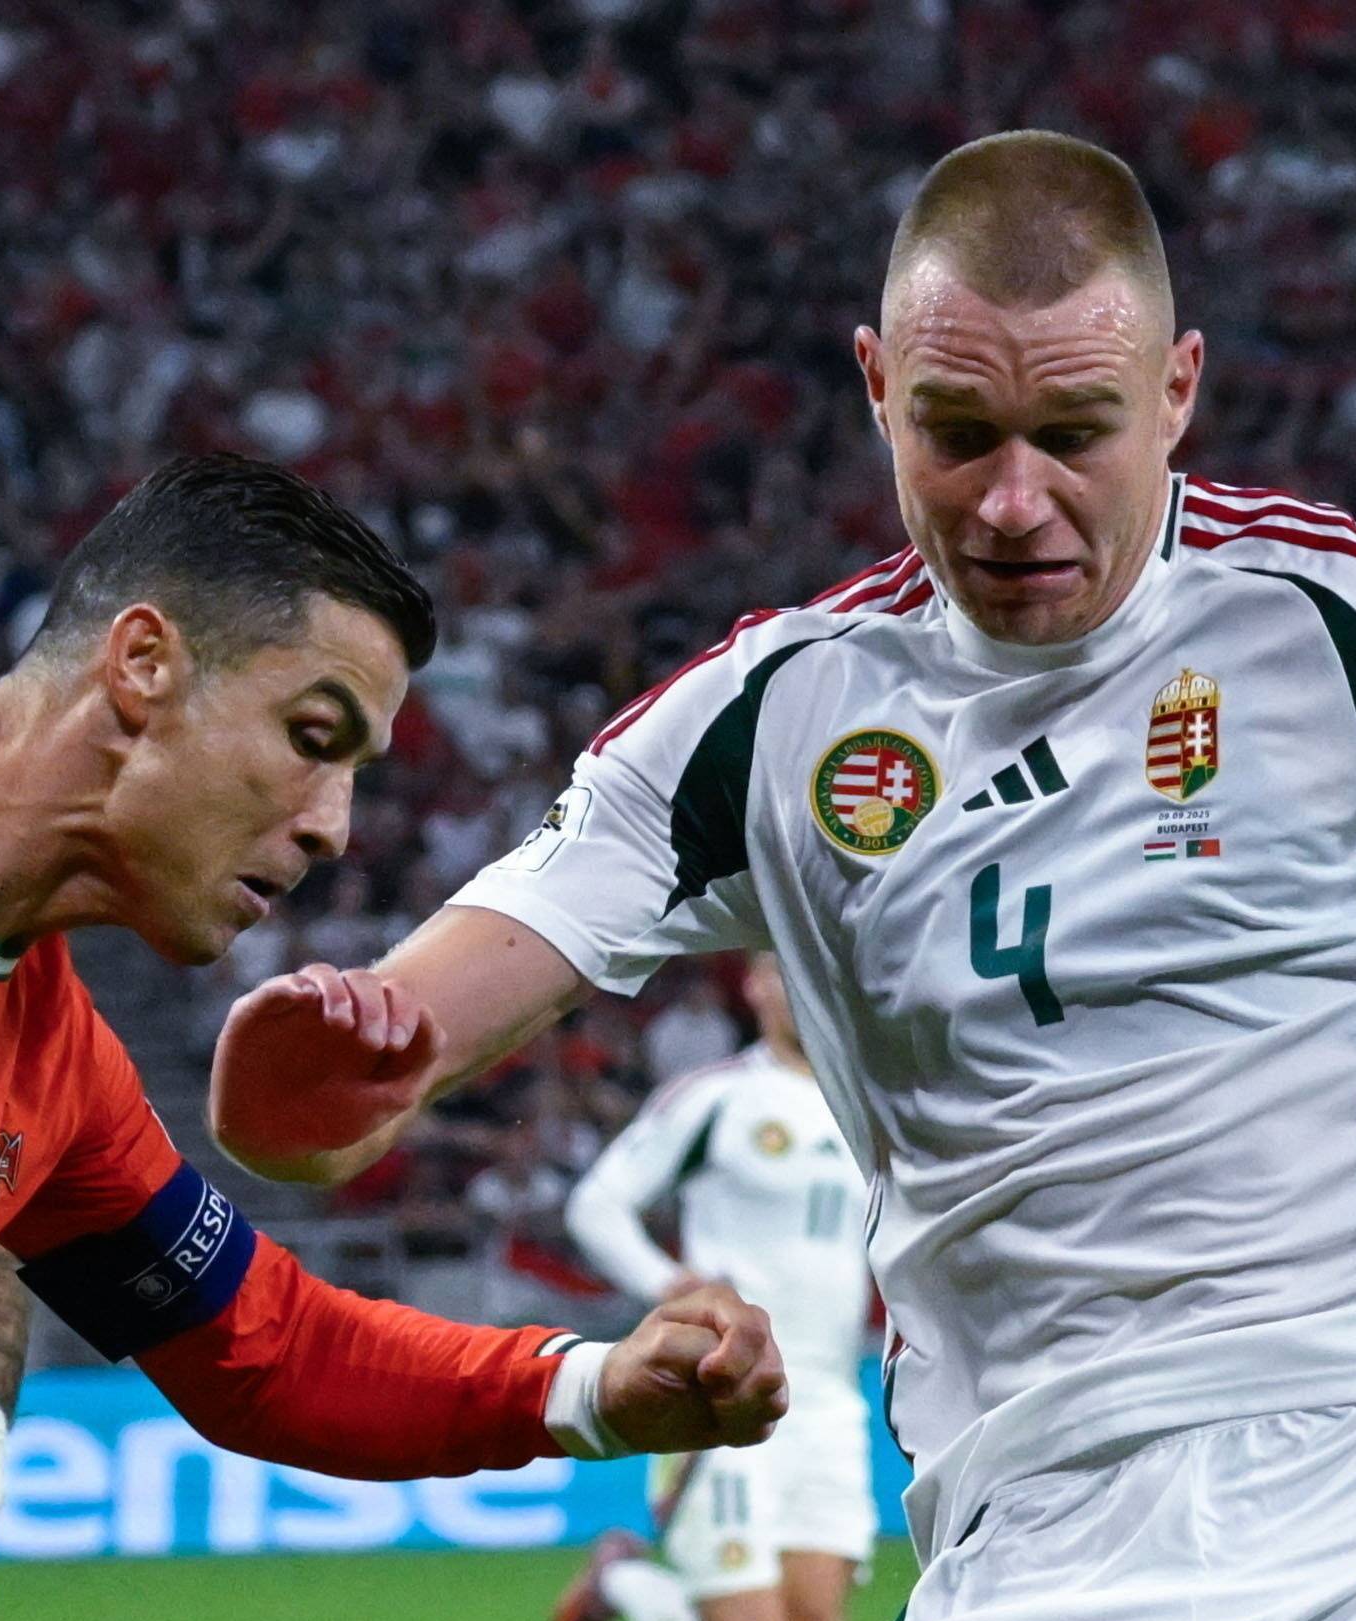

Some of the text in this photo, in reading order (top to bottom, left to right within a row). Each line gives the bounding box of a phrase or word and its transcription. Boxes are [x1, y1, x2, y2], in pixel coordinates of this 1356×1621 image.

[854, 837, 889, 849] 1901
[1157, 823, 1209, 834] BUDAPEST
[970, 863, 1065, 1027] 4
[174, 1184, 227, 1273] RESP
